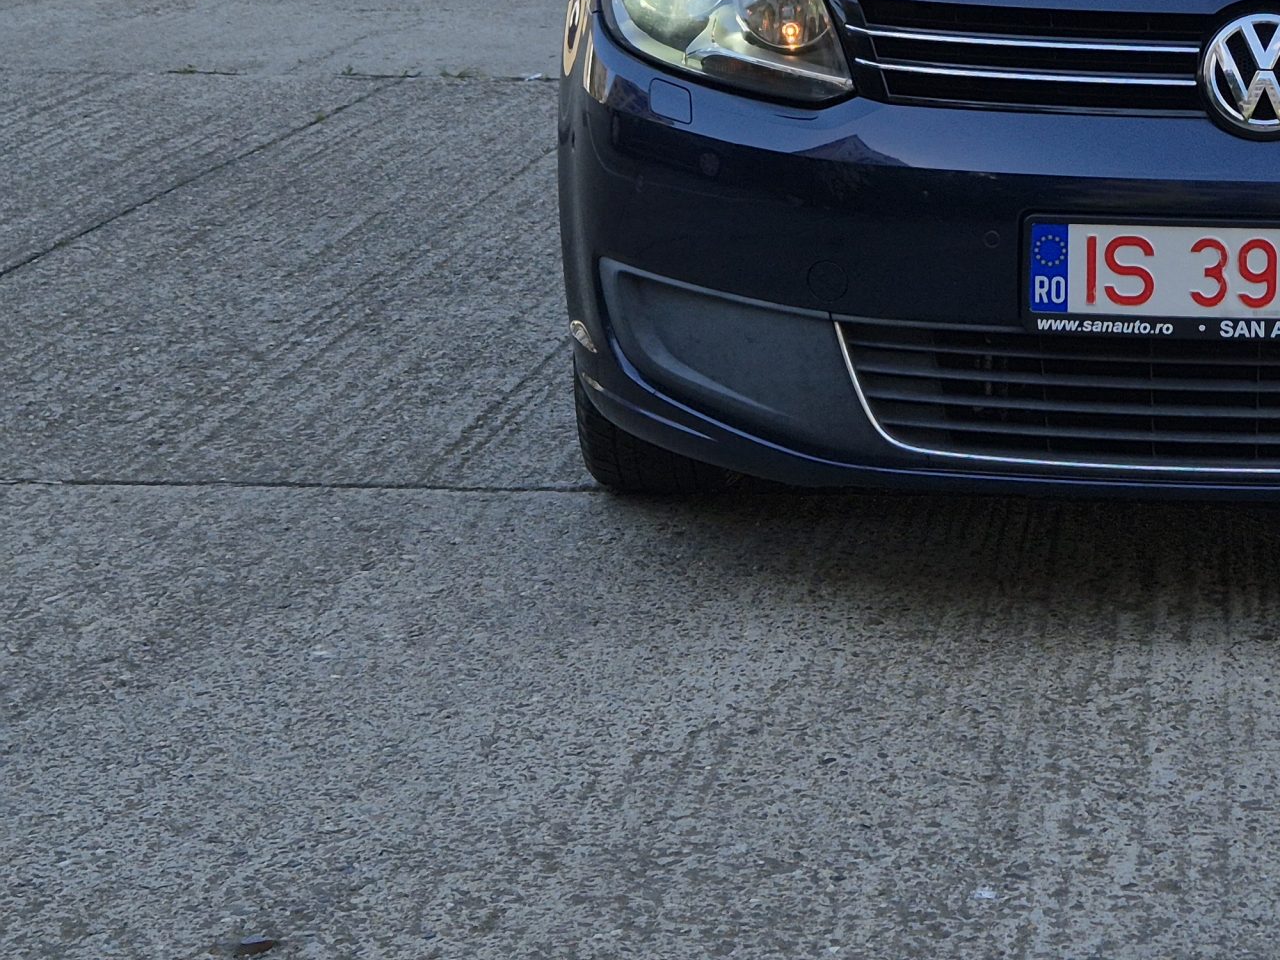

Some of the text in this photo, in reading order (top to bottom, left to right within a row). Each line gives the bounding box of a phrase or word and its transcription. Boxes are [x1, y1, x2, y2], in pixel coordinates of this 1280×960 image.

[1085, 235, 1156, 307] IS
[1034, 275, 1066, 304] RO
[1037, 317, 1174, 335] www.sanauto.ro
[1219, 320, 1265, 338] SAN
